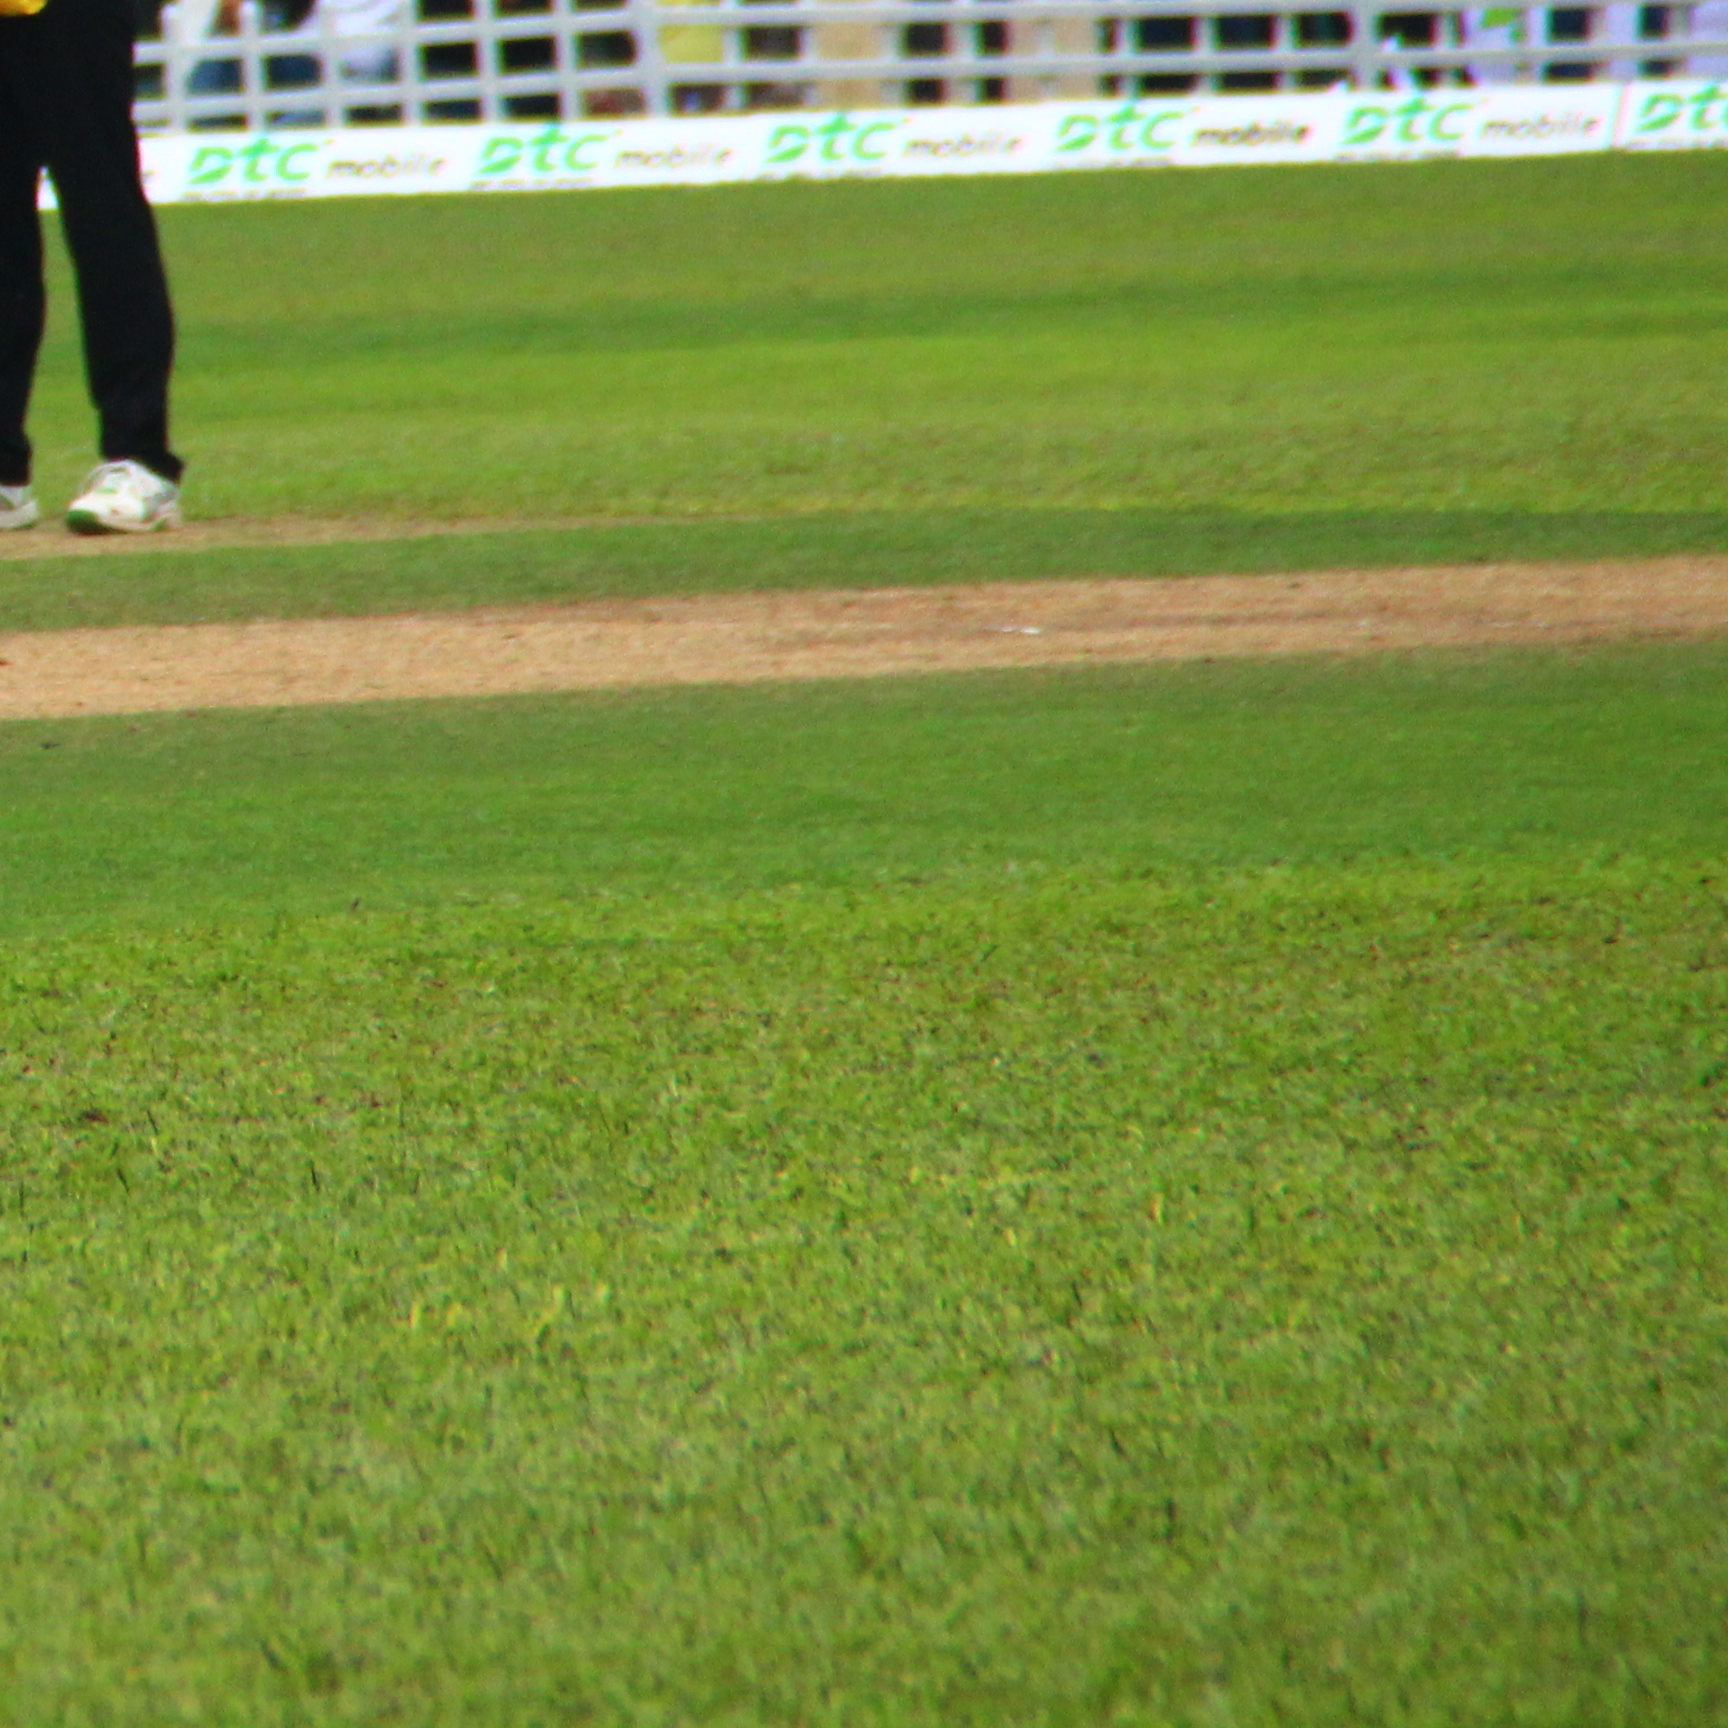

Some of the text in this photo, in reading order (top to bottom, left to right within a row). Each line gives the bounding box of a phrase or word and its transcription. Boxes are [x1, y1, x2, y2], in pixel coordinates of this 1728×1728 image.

[904, 122, 1024, 158] mobile
[1192, 112, 1312, 149] mobile
[1480, 108, 1600, 140] mobile
[325, 142, 447, 181] mobile
[615, 135, 734, 171] mobile
